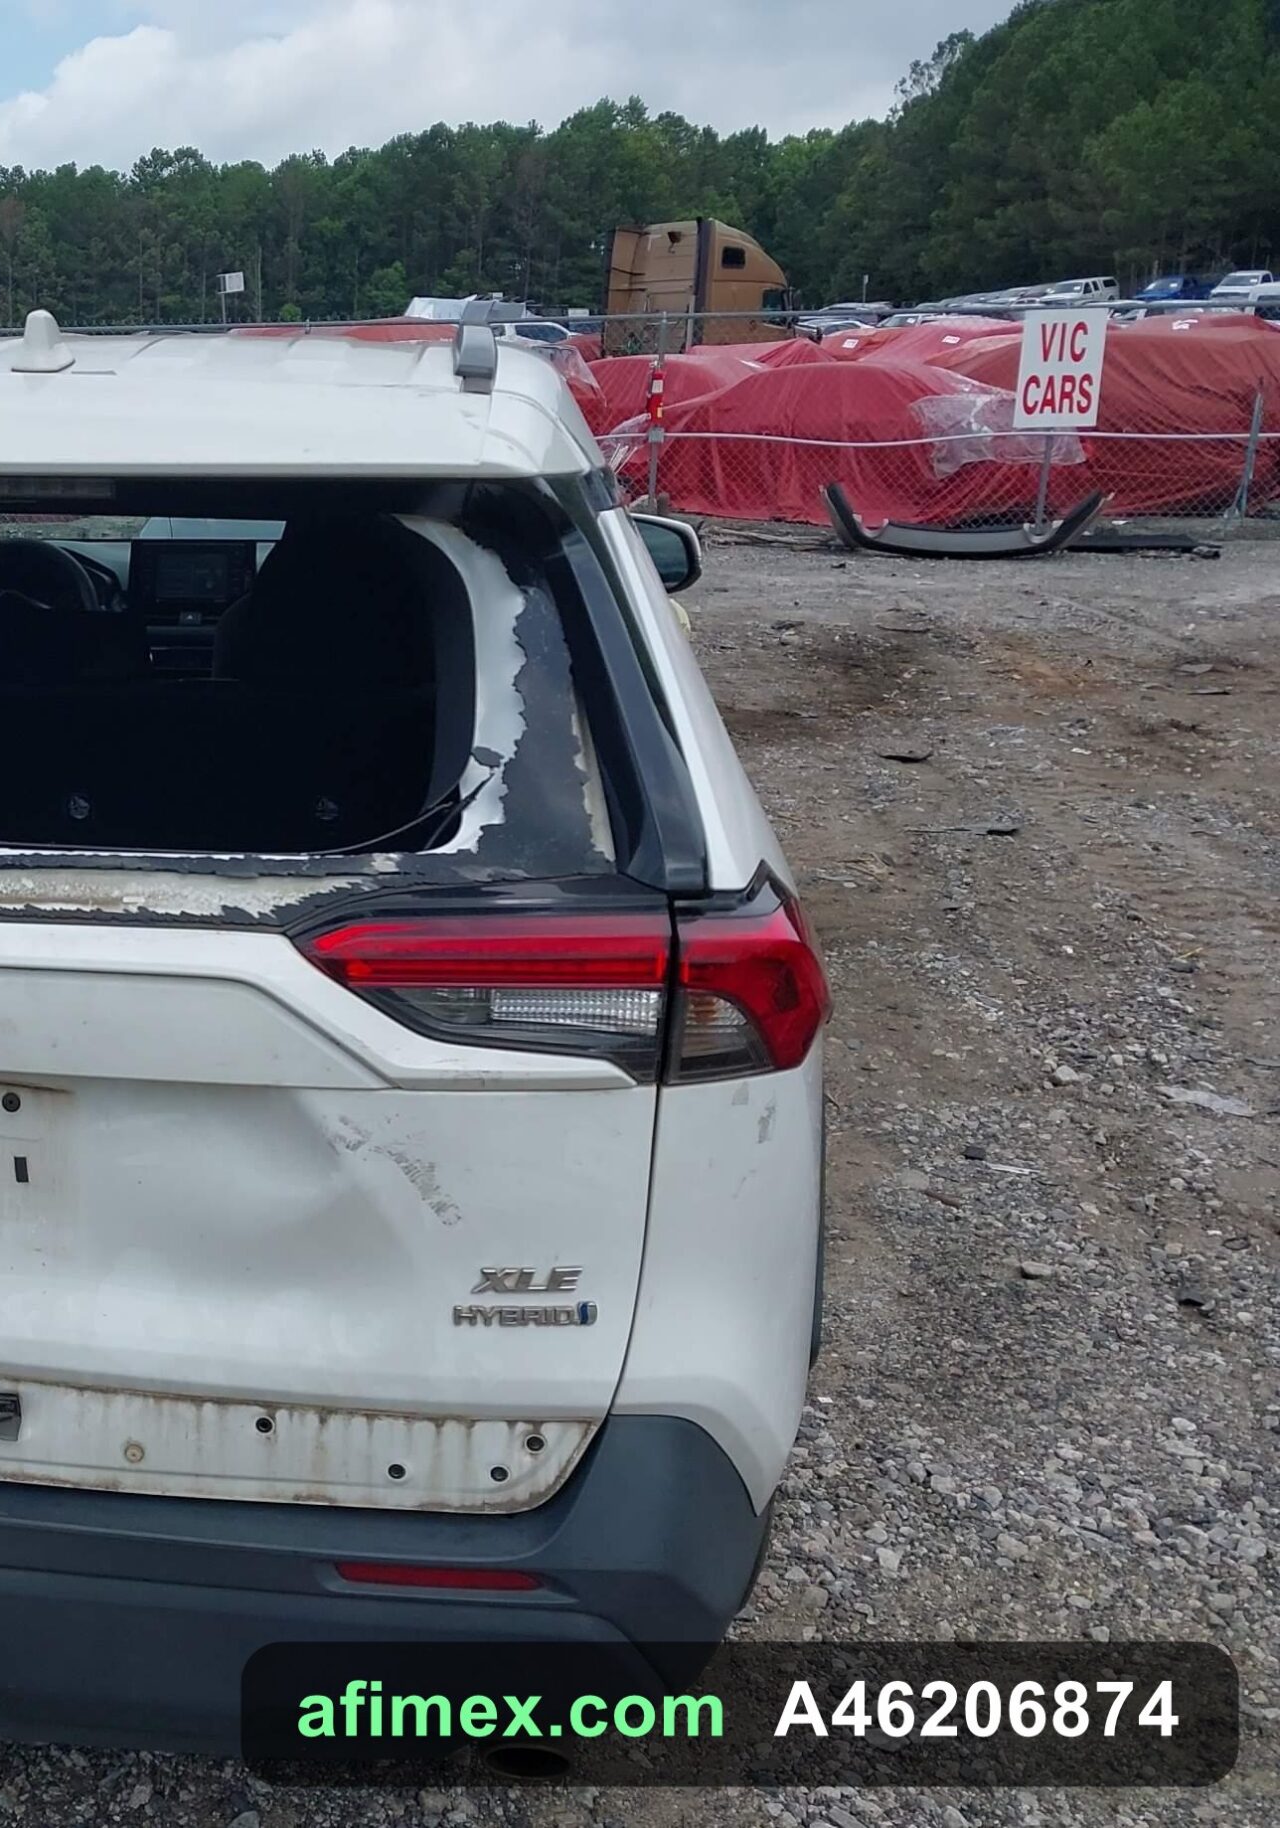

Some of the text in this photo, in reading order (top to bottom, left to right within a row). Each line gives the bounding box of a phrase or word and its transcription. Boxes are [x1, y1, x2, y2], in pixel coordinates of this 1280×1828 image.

[1041, 321, 1088, 362] VIC
[1022, 373, 1093, 415] CARS
[471, 1266, 584, 1294] XLE
[453, 1304, 575, 1327] HYBRID
